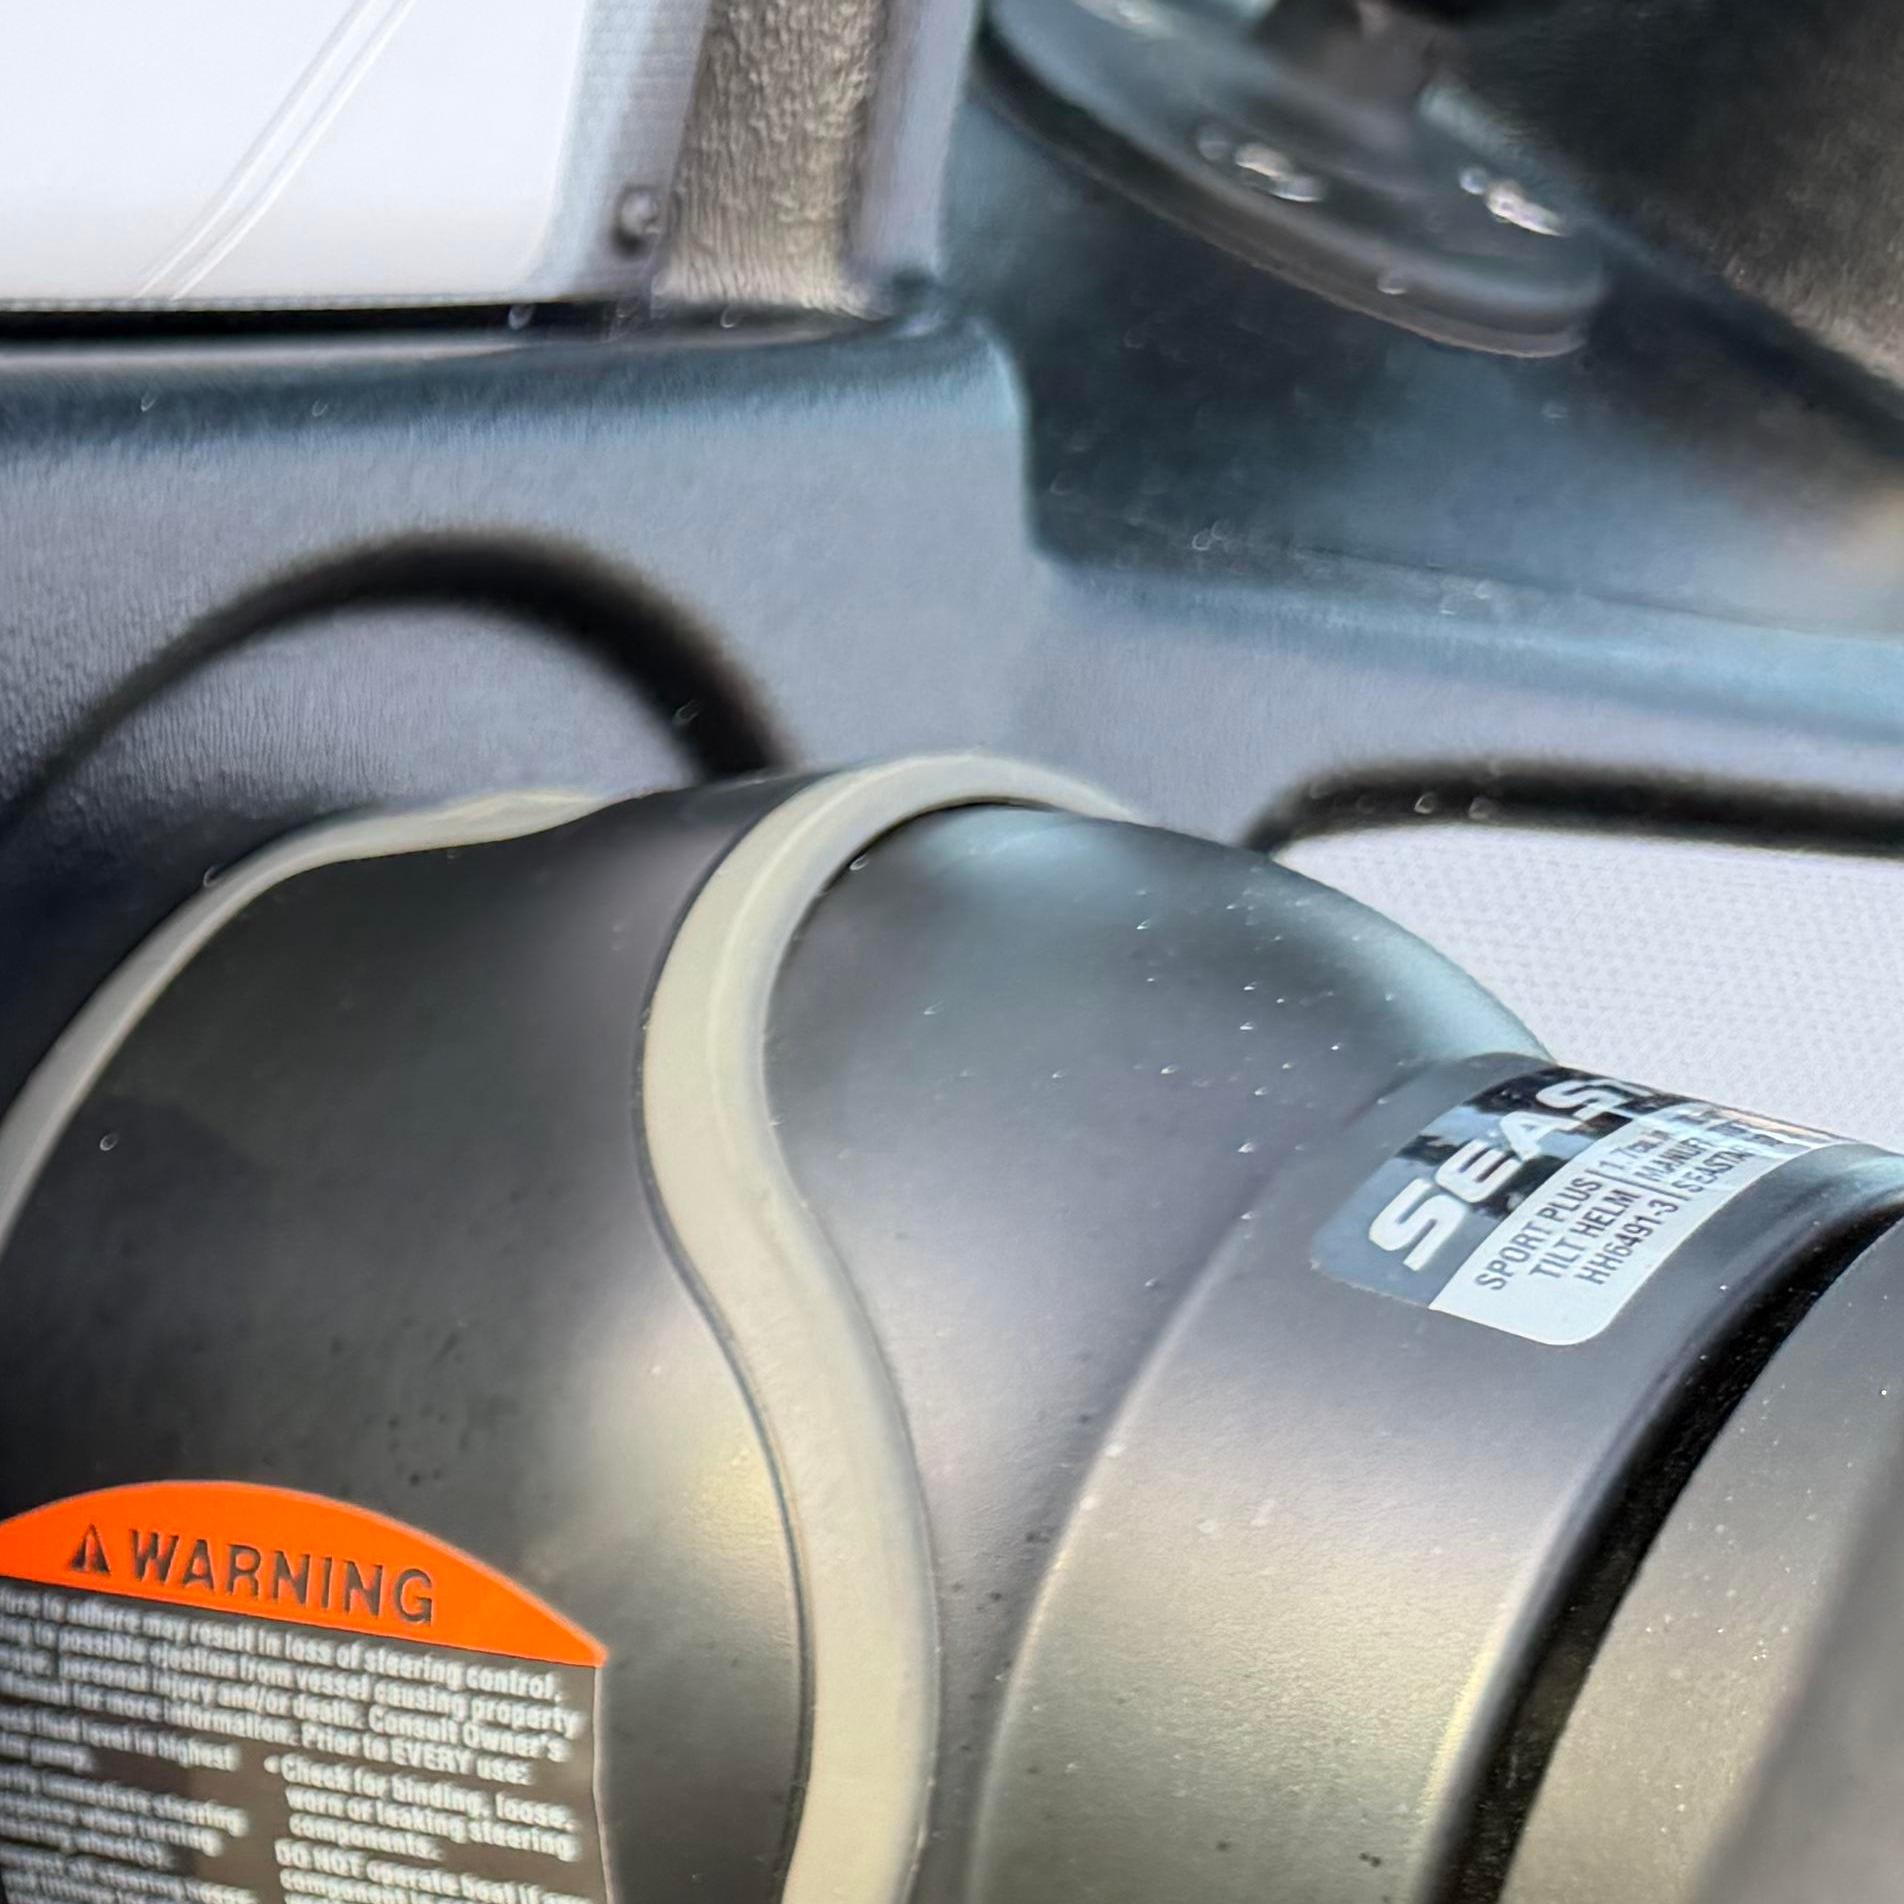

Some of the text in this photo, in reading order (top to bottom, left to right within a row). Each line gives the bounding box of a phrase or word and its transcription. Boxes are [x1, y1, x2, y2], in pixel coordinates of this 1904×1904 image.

[1475, 1177, 1603, 1291] SPORT PLUS
[1528, 1188, 1642, 1279] TILT HELM
[1574, 1199, 1678, 1286] HH6491-3
[129, 1529, 433, 1625] WARNING
[284, 1633, 331, 1663] loss
[336, 1639, 361, 1668] of
[364, 1645, 463, 1689] steering
[217, 1682, 288, 1714] and/or
[368, 1706, 458, 1742] Consult
[297, 1667, 369, 1698] vessel
[374, 1679, 466, 1720] causing
[470, 1696, 582, 1739] property
[281, 1755, 352, 1790] Check
[354, 1767, 384, 1796] for
[302, 1724, 361, 1754] Prior
[363, 1735, 388, 1759] to
[391, 1739, 474, 1775] EVERY
[274, 1837, 309, 1866] DO
[313, 1845, 362, 1875] NOT
[468, 1818, 581, 1862] steering
